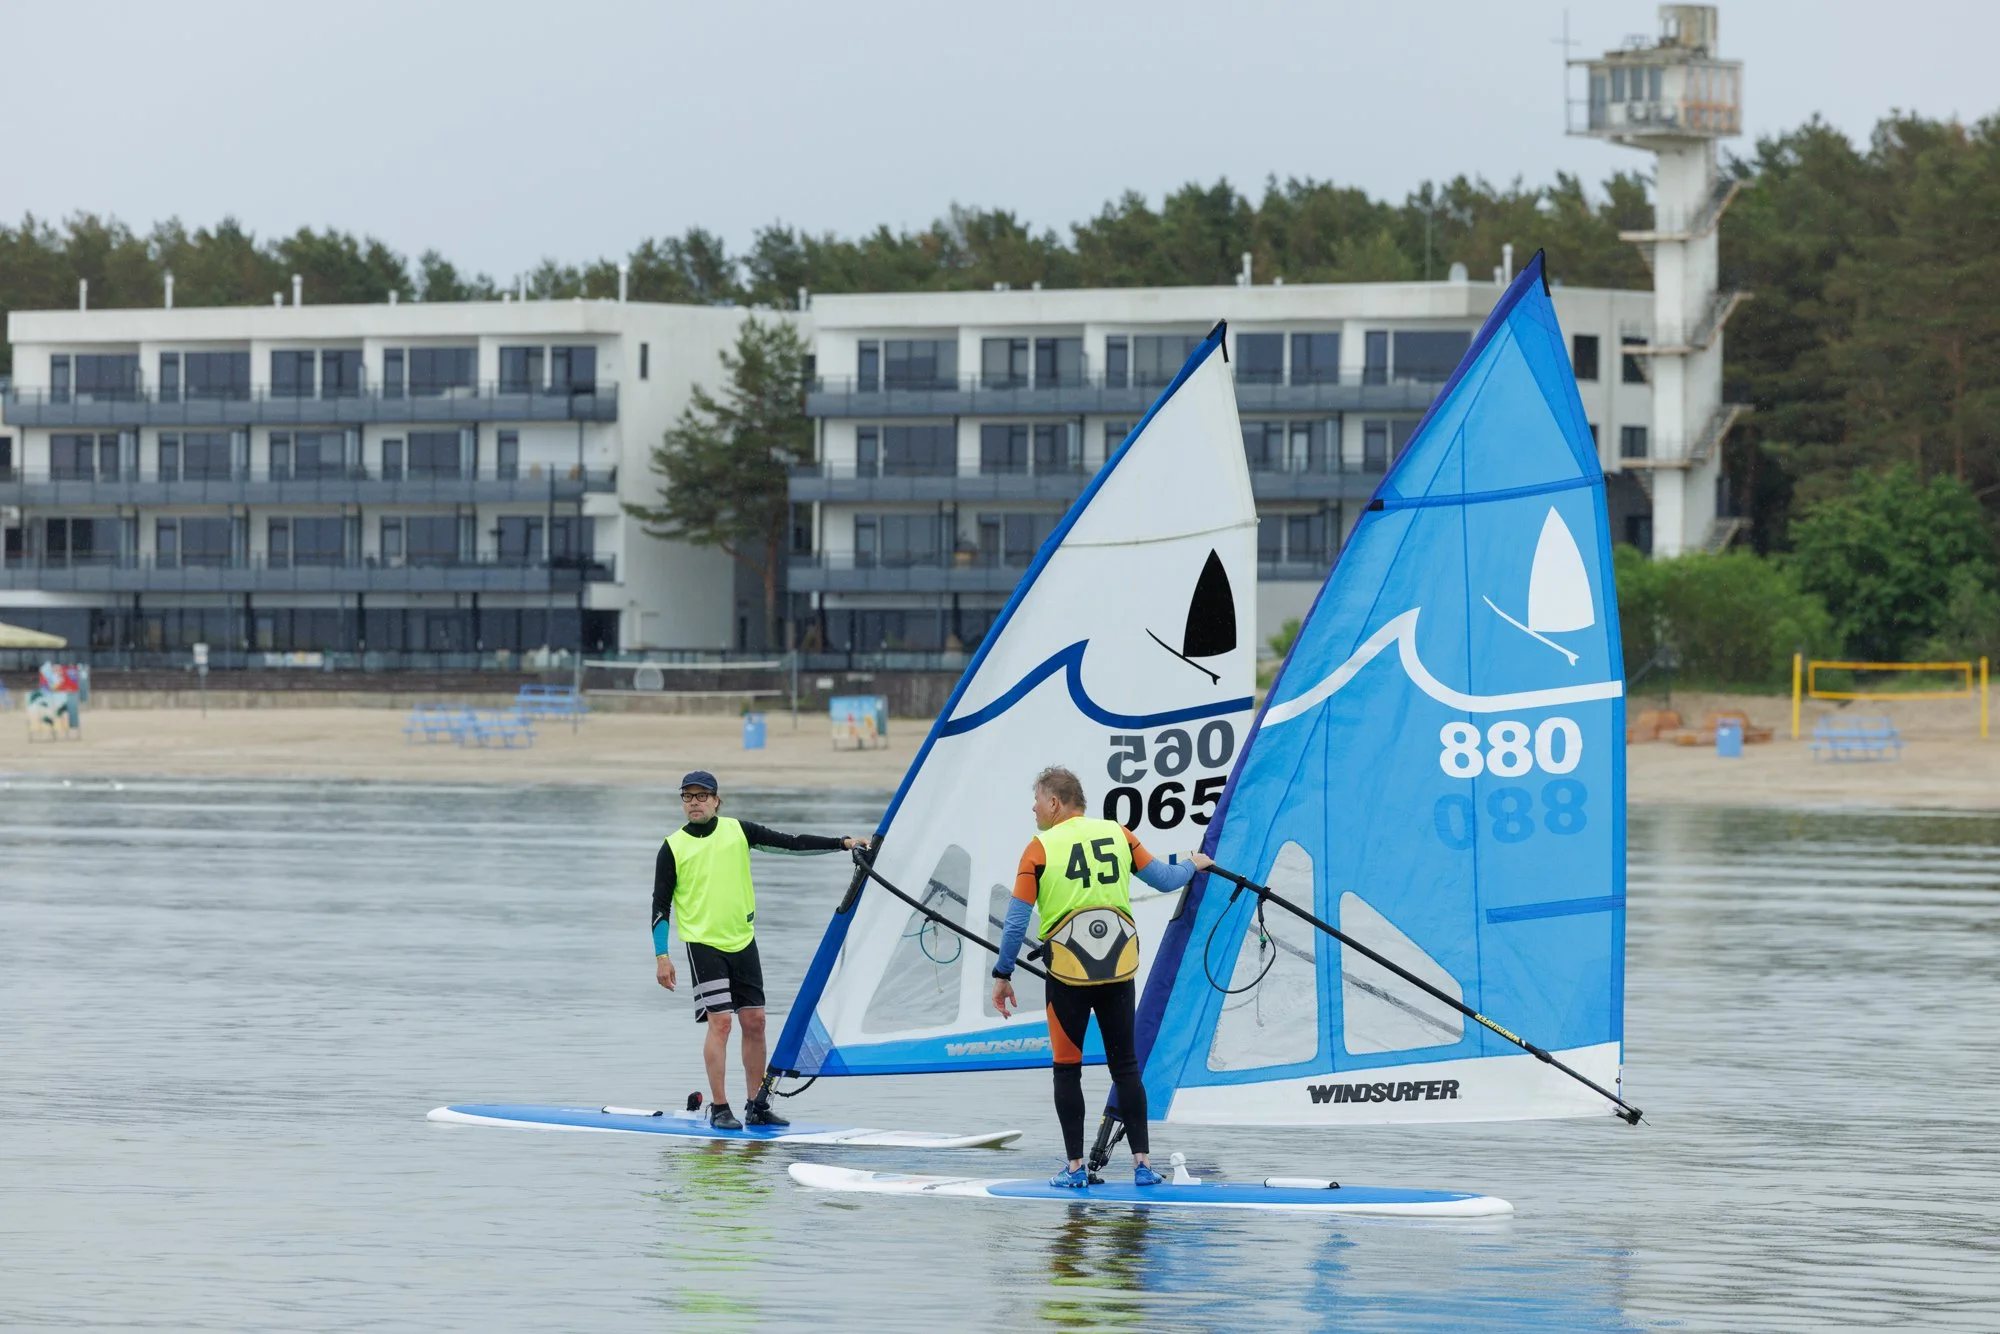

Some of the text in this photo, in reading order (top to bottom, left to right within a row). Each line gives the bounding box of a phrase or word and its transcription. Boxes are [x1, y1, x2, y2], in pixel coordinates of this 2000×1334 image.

[1439, 716, 1583, 778] 880
[1103, 775, 1227, 832] 065
[1065, 837, 1120, 888] 45
[944, 1037, 1052, 1056] WINDSURF
[1307, 1079, 1460, 1104] WINDSURFER
